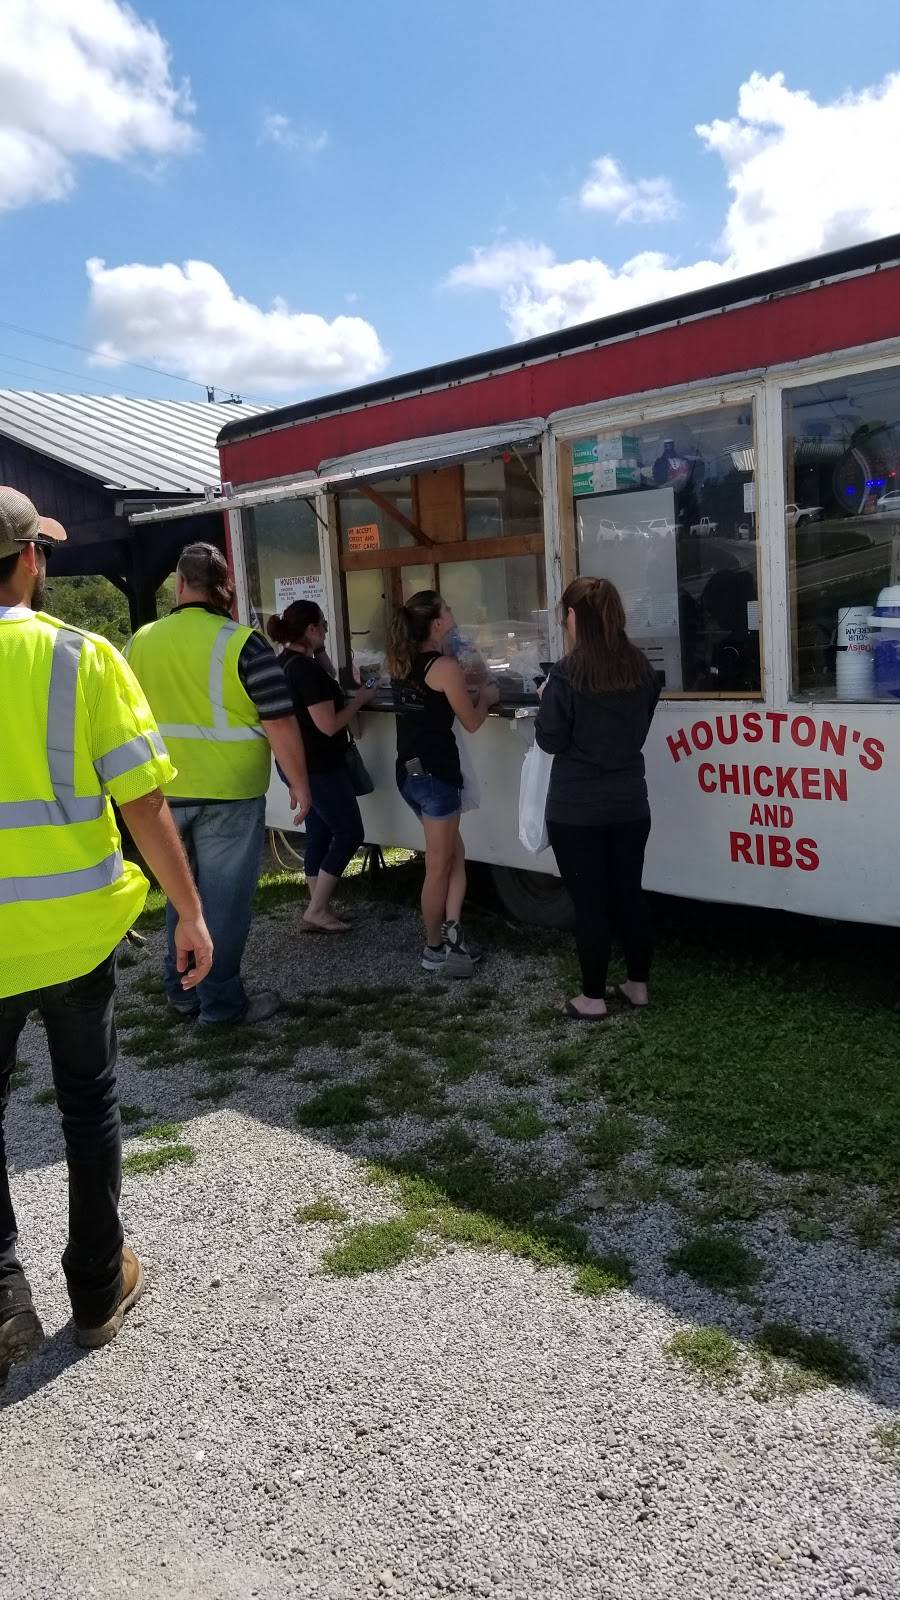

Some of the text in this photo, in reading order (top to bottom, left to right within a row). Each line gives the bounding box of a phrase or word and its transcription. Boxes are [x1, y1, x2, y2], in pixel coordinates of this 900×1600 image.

[280, 574, 320, 586] HOUSTON'S MENU
[845, 627, 870, 635] CREAM
[847, 643, 873, 652] Daisy
[666, 712, 885, 772] HOUSTON'S
[698, 762, 848, 801] CHICKEN
[750, 803, 794, 829] AND
[729, 831, 820, 872] RIBS
